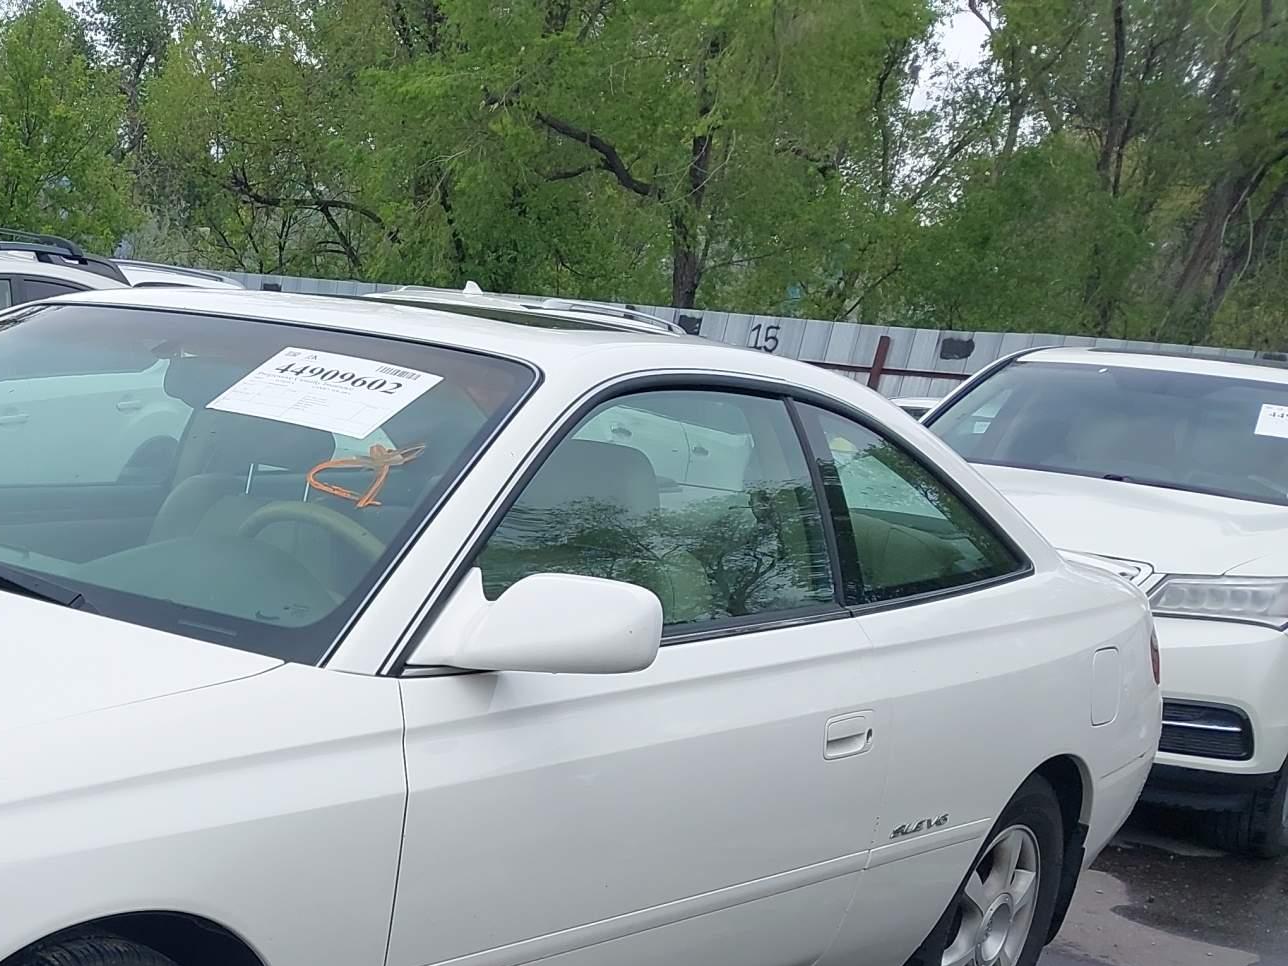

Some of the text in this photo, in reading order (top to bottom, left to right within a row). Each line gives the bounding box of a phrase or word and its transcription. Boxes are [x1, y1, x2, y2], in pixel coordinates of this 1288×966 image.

[750, 323, 781, 353] 15
[275, 362, 403, 395] 44909602
[926, 813, 949, 830] V6
